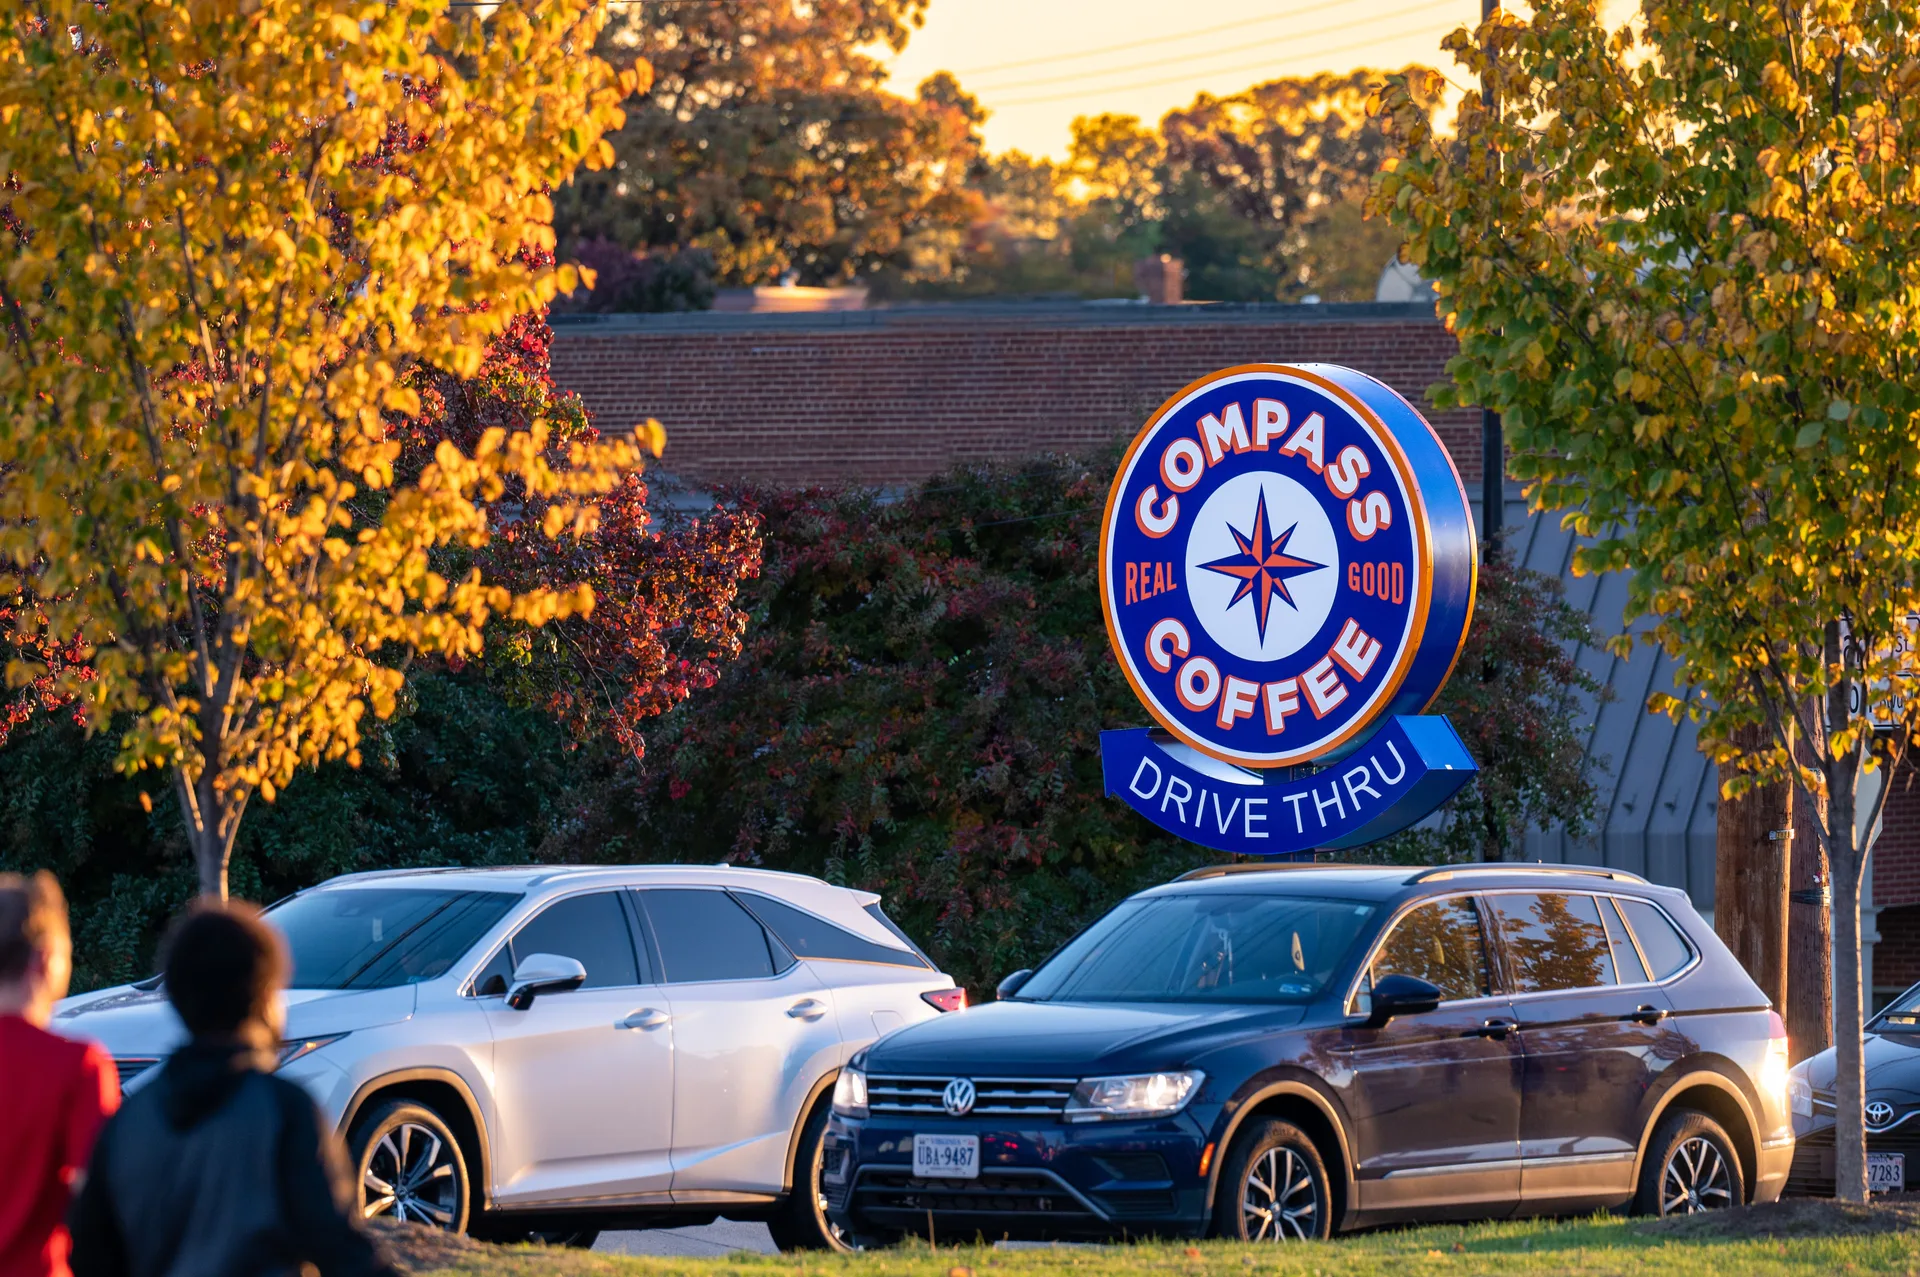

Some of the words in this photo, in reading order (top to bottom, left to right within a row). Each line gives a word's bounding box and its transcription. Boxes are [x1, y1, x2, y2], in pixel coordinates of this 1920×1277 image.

[1134, 397, 1392, 542] COMPASS
[1125, 561, 1177, 606] REAL
[1348, 561, 1404, 605] GOOD
[1144, 616, 1382, 736] COFFEE
[1128, 755, 1270, 838] DRIVE
[1281, 739, 1407, 833] THRU
